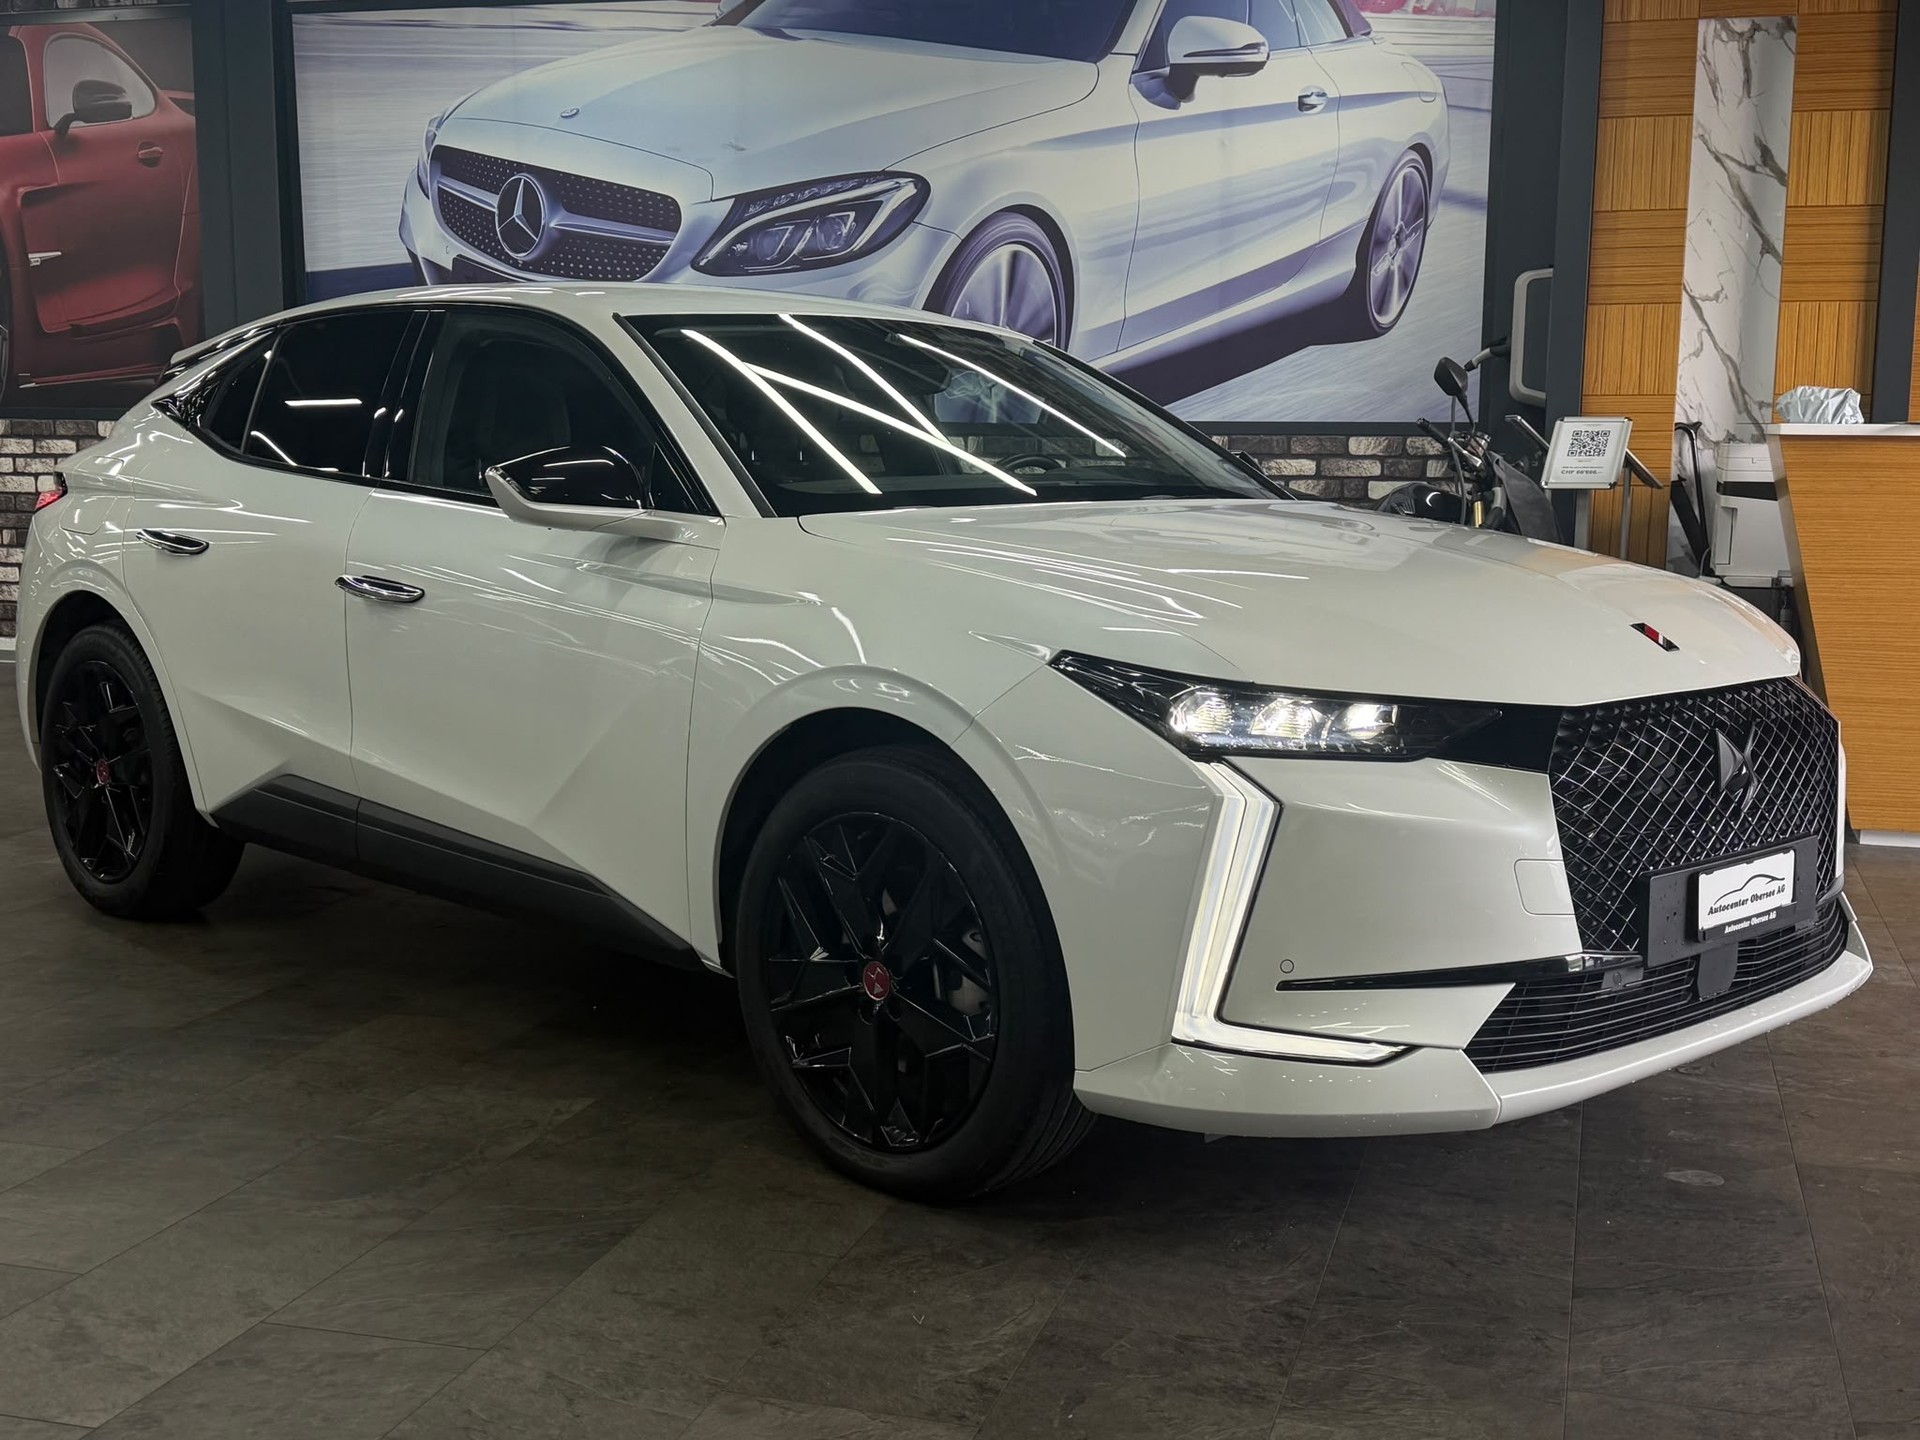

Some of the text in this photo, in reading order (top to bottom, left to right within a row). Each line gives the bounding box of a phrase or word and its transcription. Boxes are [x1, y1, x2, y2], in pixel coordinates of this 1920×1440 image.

[1708, 884, 1785, 915] Autocenter Obersee AG
[1724, 910, 1777, 934] Autocenter Obersee AG
